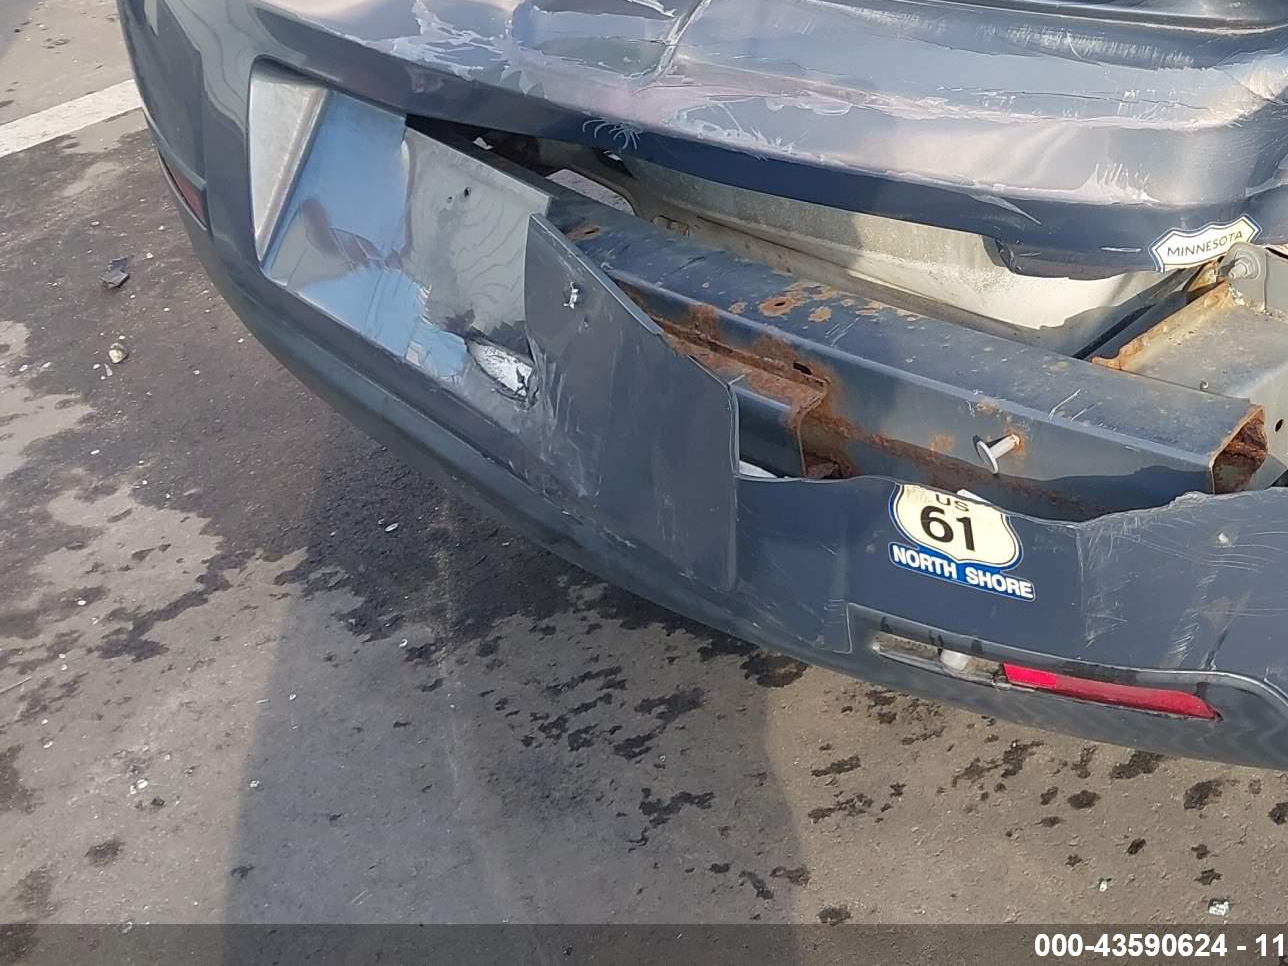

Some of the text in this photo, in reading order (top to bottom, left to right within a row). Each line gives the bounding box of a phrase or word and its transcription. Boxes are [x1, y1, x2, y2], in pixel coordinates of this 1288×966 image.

[1167, 231, 1242, 256] MINNESOTA
[936, 494, 969, 512] US
[920, 505, 975, 552] 61
[893, 545, 1034, 599] NORTH SHORE
